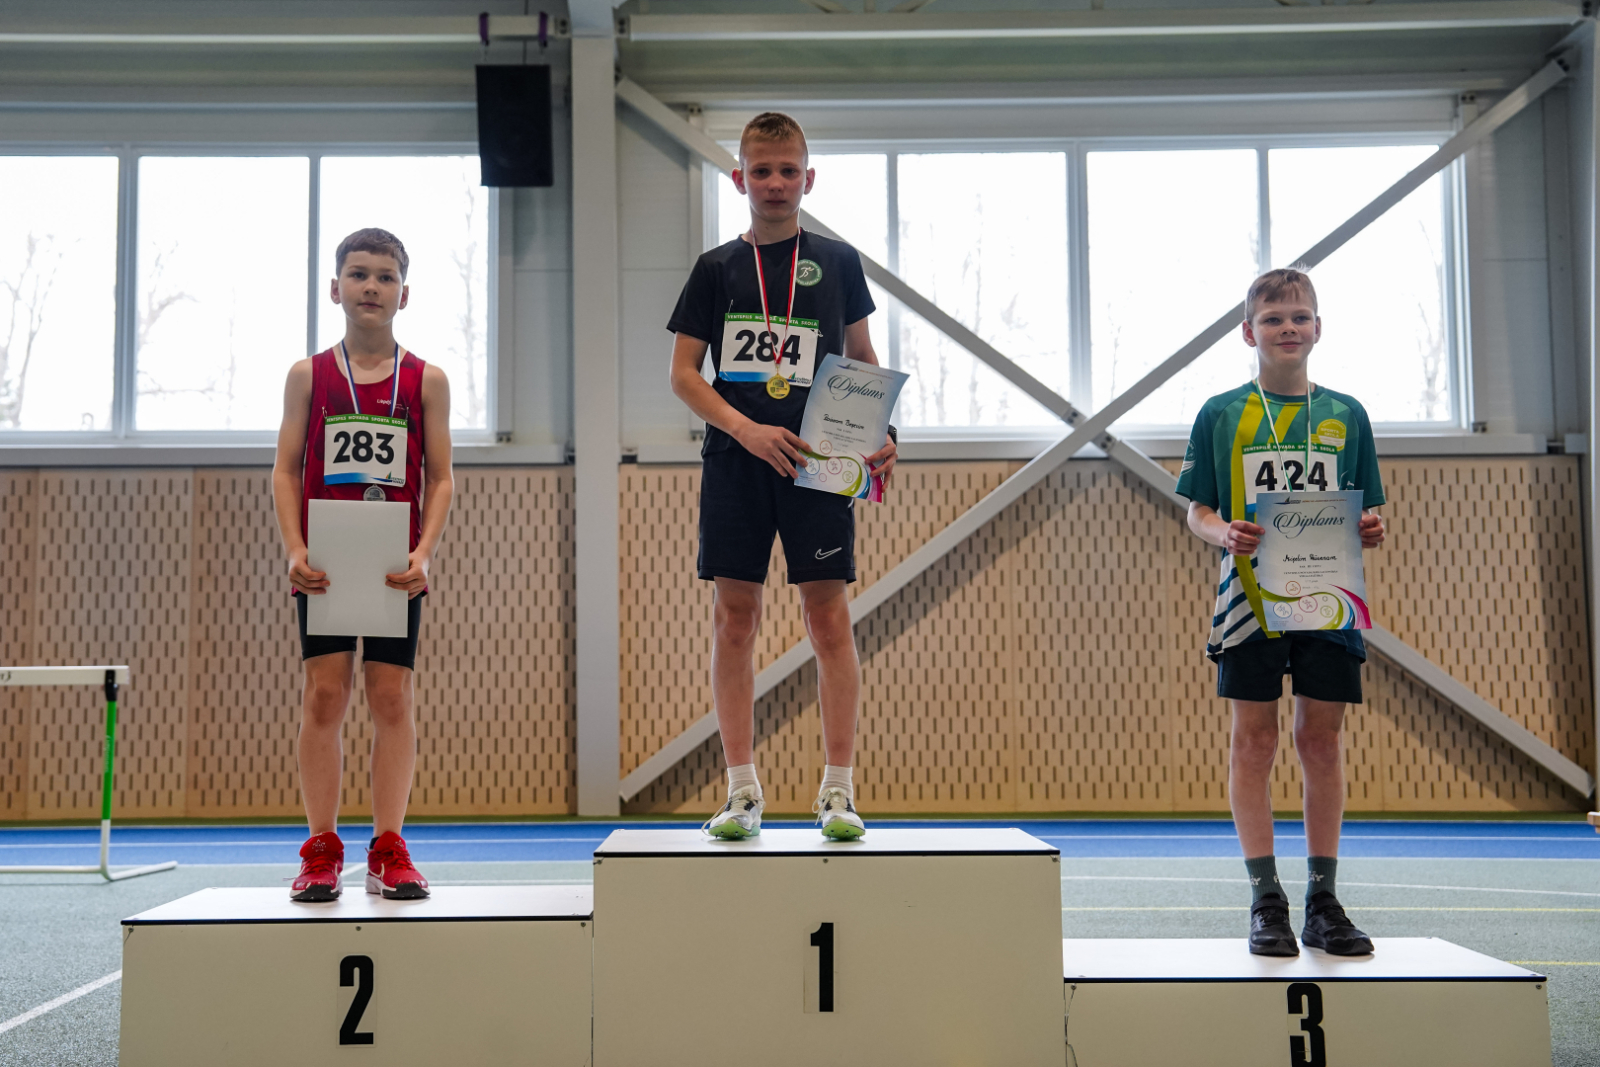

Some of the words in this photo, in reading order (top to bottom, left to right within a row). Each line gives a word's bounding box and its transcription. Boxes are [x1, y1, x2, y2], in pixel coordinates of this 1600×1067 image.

[733, 329, 801, 366] 284
[827, 374, 886, 402] Diploms
[333, 430, 395, 465] 283
[1255, 460, 1328, 492] 424
[1273, 506, 1345, 540] Diploms
[810, 922, 834, 1012] 1
[340, 955, 374, 1045] 2
[1286, 982, 1326, 1067] 3
